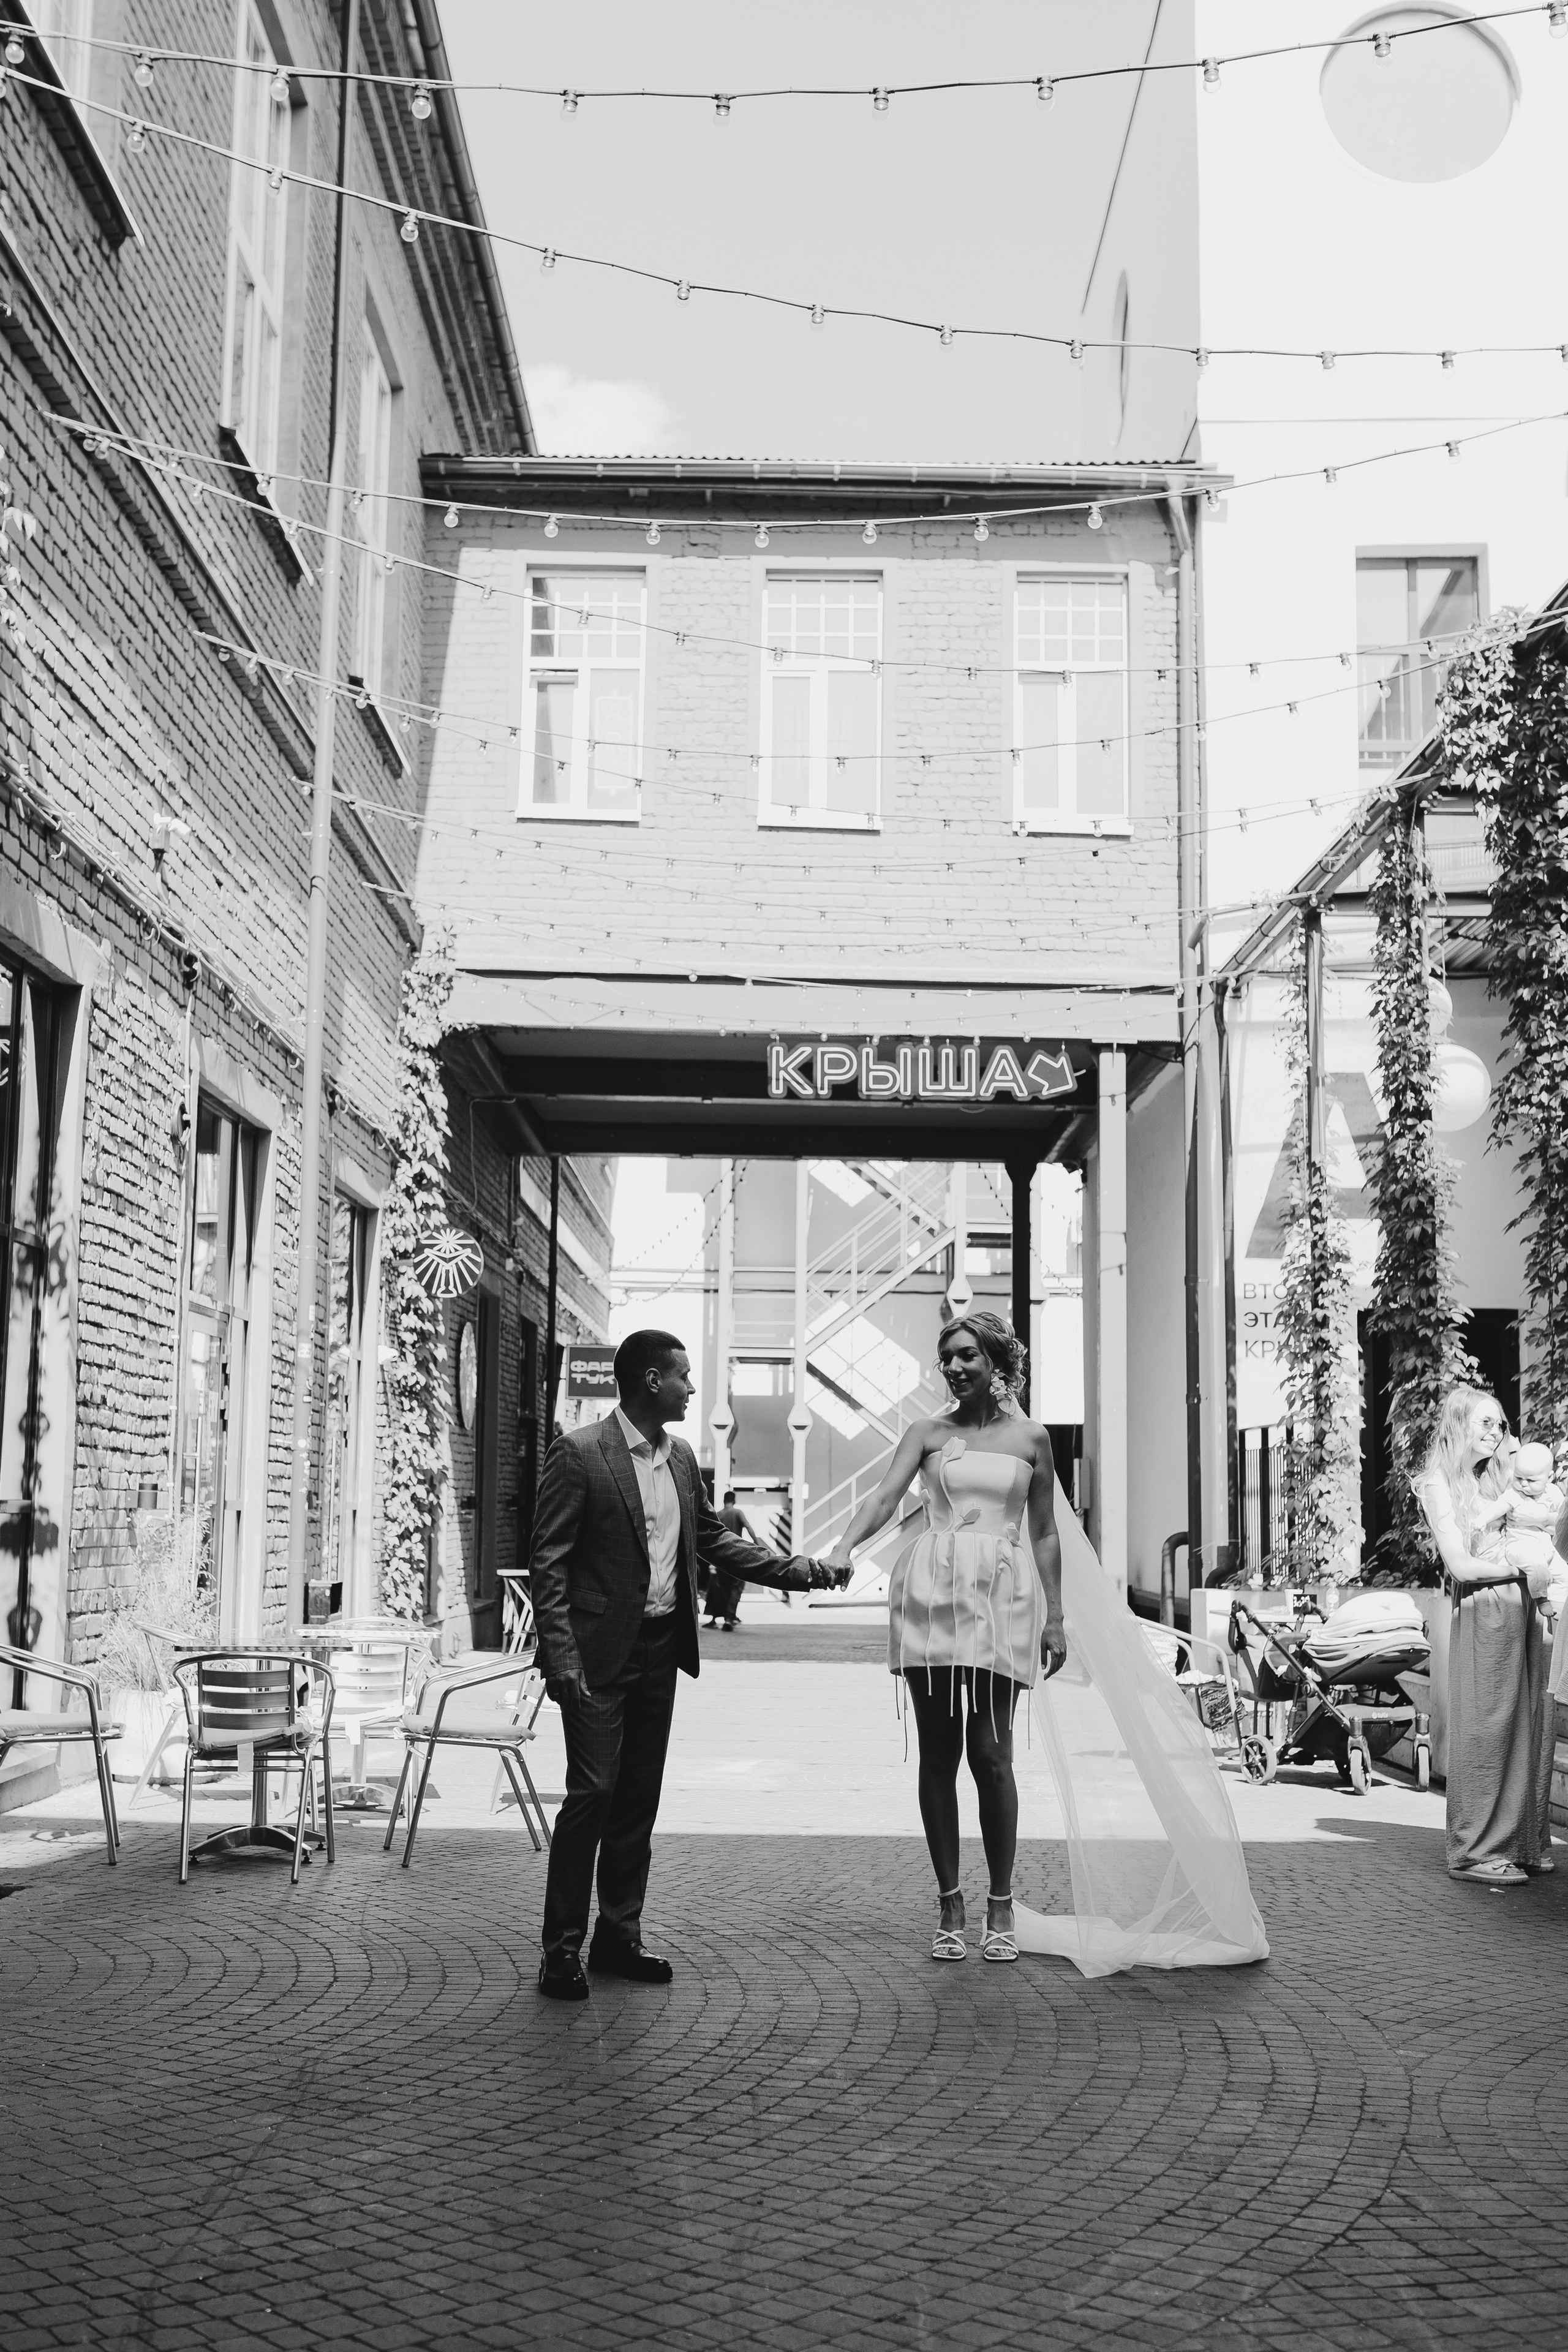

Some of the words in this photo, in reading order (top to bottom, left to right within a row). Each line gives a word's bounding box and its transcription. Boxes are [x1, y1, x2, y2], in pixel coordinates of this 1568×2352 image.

[769, 1043, 1031, 1099] КРЫША
[1243, 1283, 1288, 1299] ВТО
[1244, 1312, 1288, 1328] ЭТА
